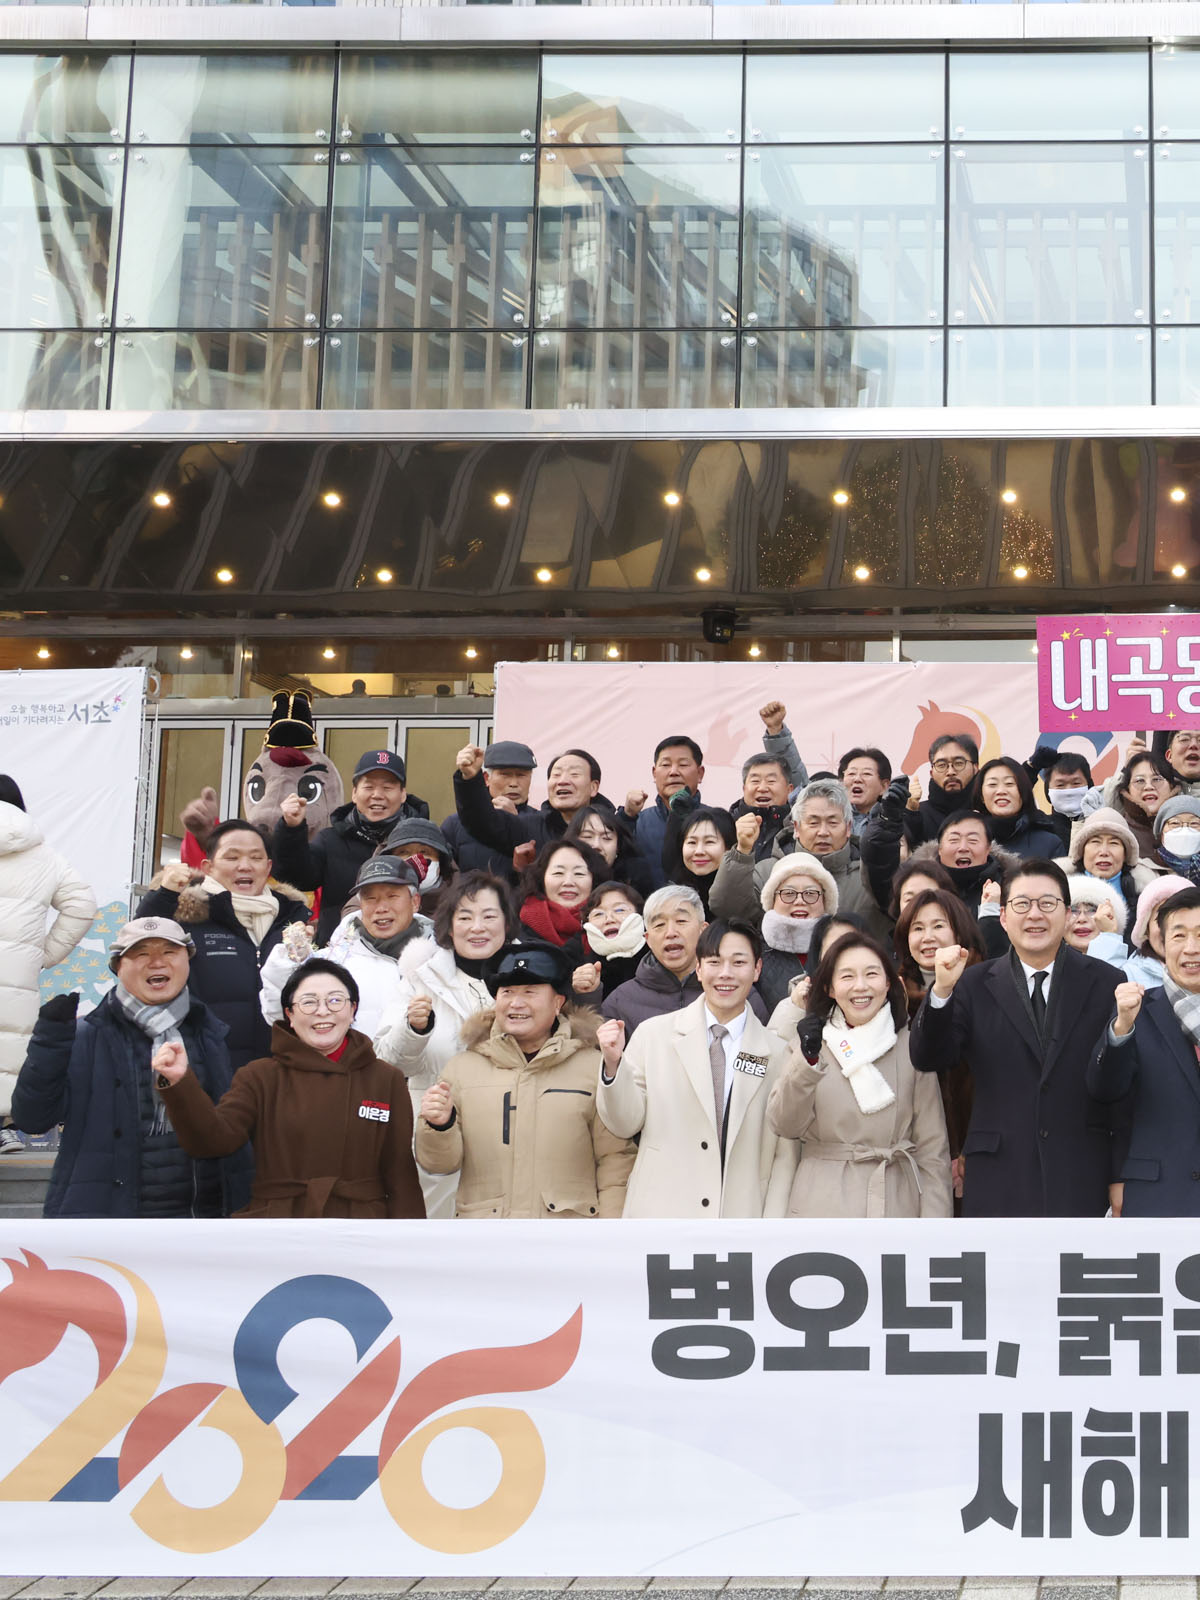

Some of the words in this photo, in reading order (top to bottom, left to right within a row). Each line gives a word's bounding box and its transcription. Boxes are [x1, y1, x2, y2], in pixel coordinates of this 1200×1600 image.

[67, 701, 112, 725] 서초
[376, 751, 390, 765] B
[734, 1058, 767, 1078] 이형준
[358, 1105, 391, 1123] 이은경
[647, 1252, 1020, 1379] 병오년,
[961, 1409, 1189, 1538] 새해
